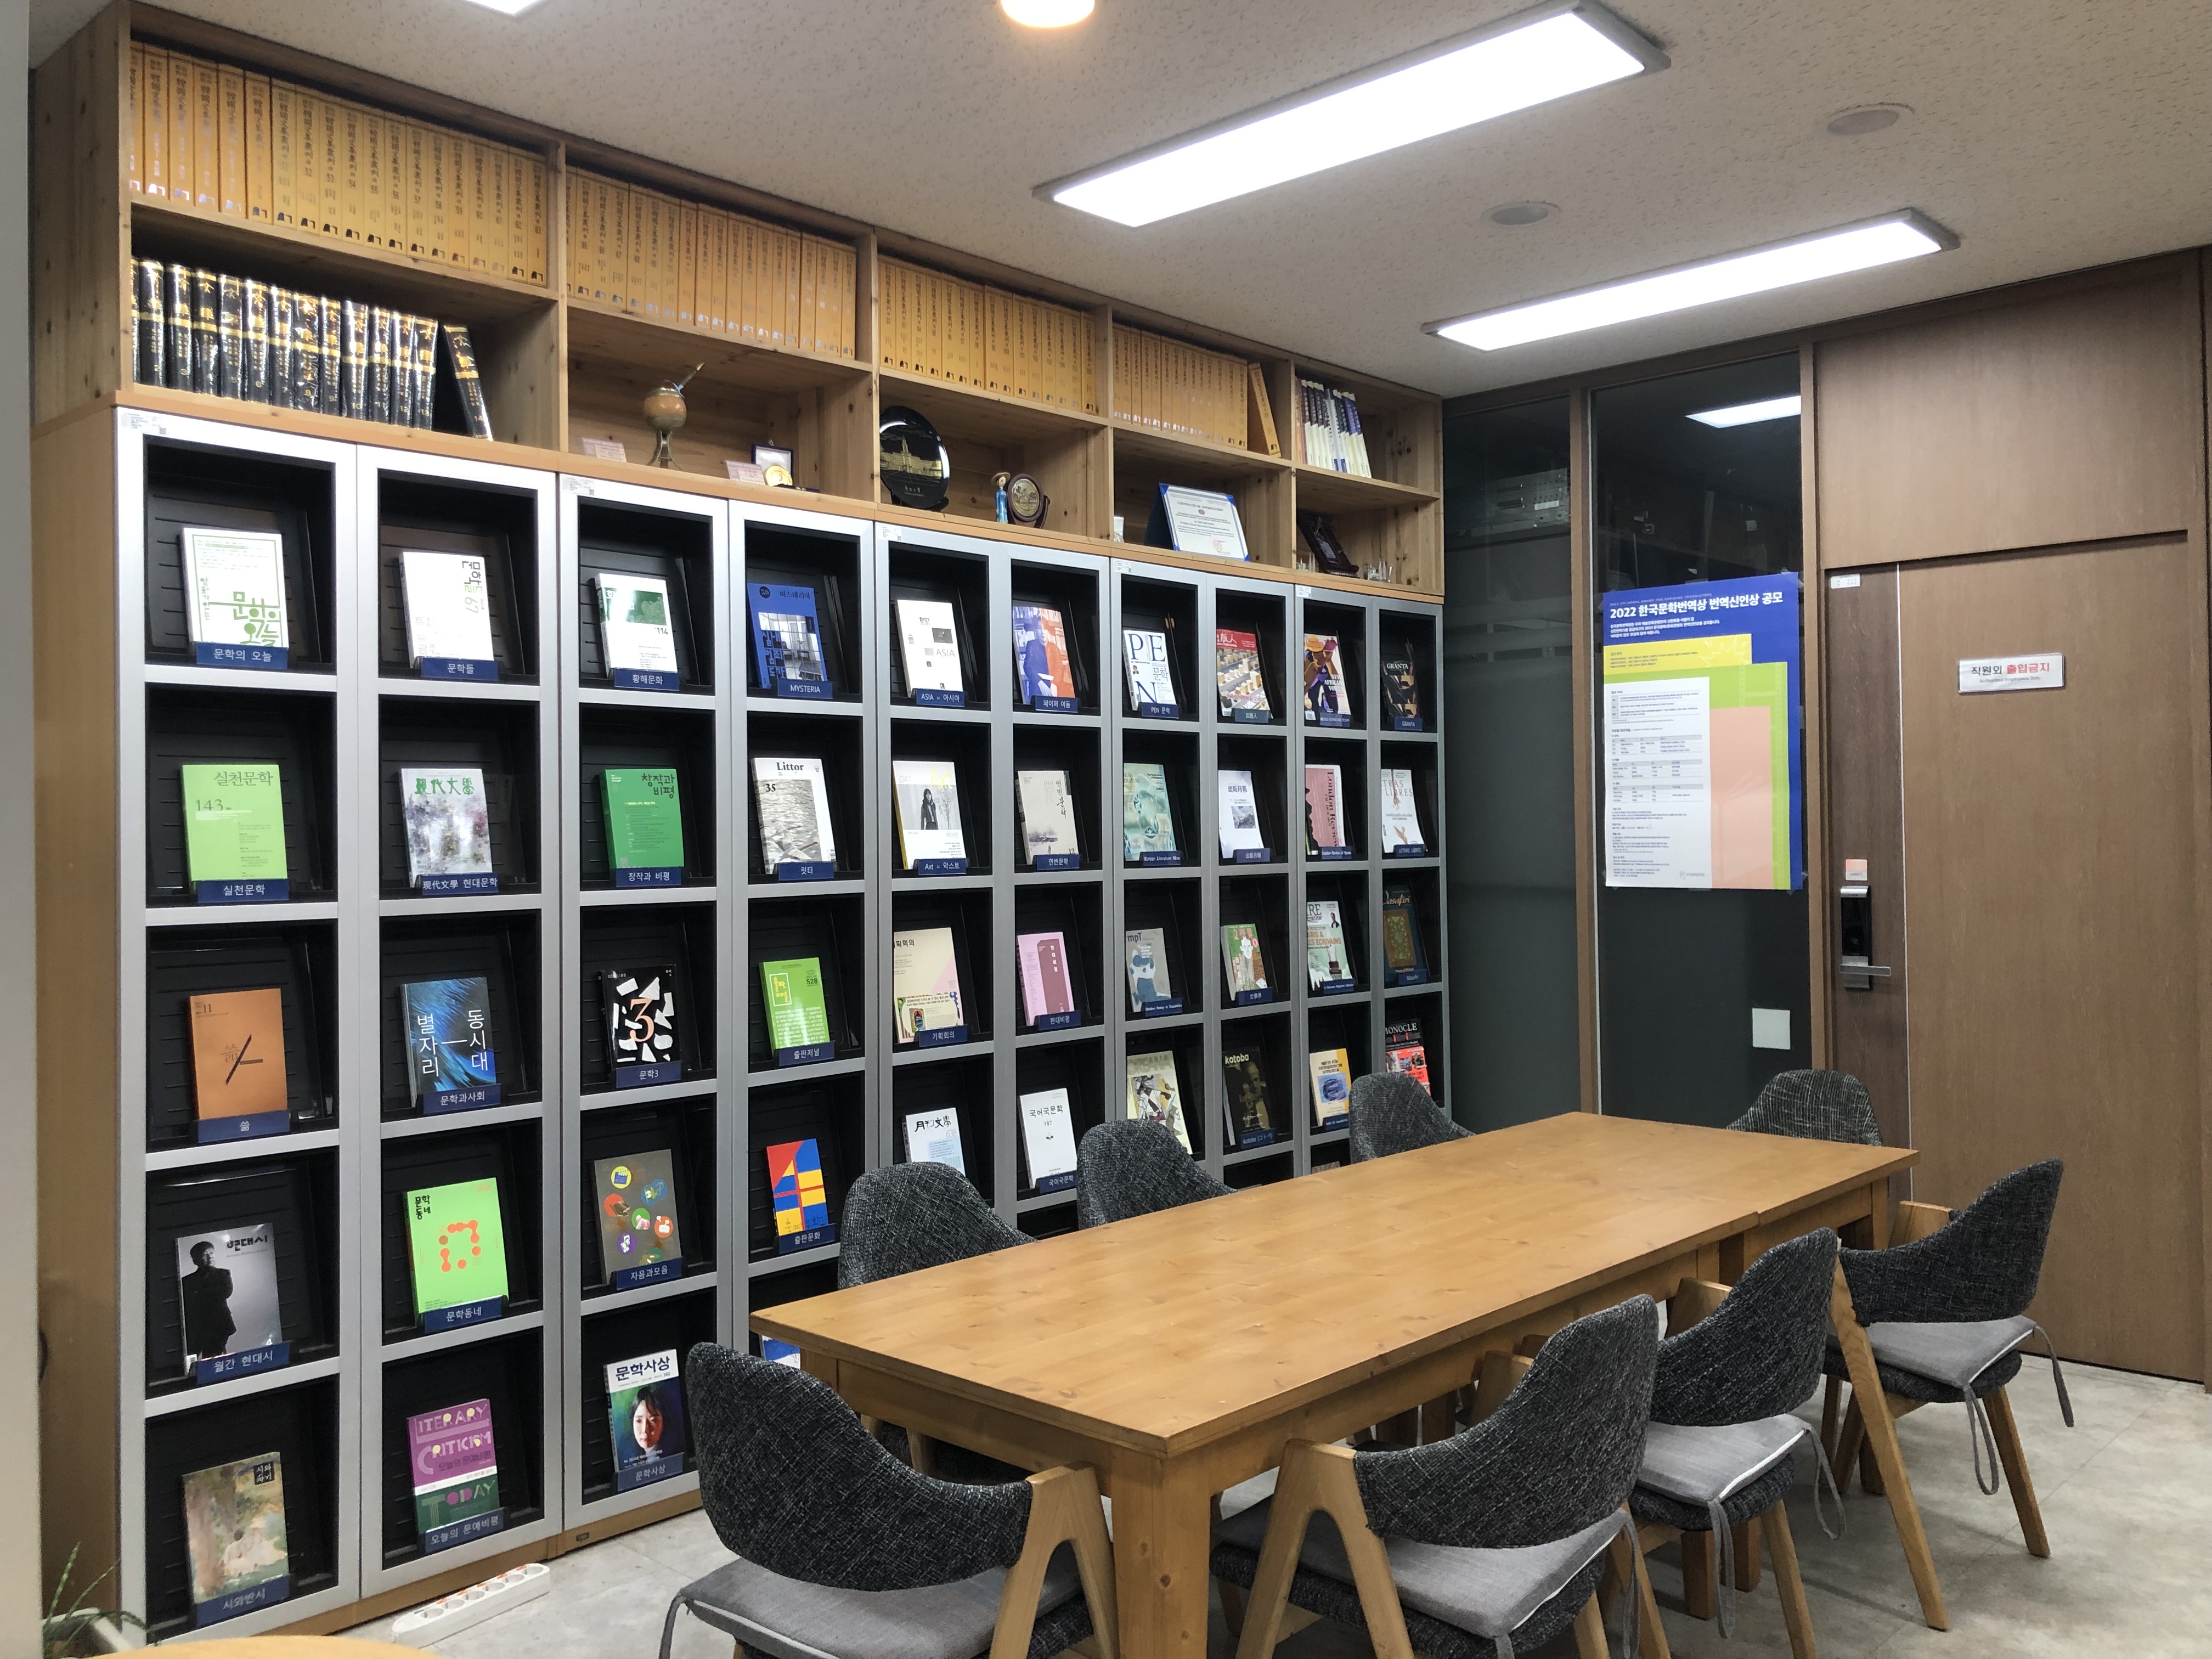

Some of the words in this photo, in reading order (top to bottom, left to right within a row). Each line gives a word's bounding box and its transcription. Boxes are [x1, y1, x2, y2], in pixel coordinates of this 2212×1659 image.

[779, 590, 811, 600] 미스테리아
[1610, 607, 1637, 619] 2022
[1638, 599, 1708, 617] 한국문학번역상
[1709, 593, 1760, 610] 번역신인상
[1762, 591, 1784, 605] 공모
[214, 648, 245, 661] 문학의
[252, 651, 272, 662] 오늘
[936, 648, 955, 657] ASIA
[448, 663, 475, 674] 문학들
[1153, 667, 1169, 681] 문학
[1971, 665, 2002, 675] 직원외
[2007, 662, 2050, 674] 출입금지
[633, 674, 663, 685] 황해문화
[790, 685, 821, 693] MYSTERIA
[1043, 699, 1058, 708] 페이퍼
[776, 762, 804, 771] Littor
[213, 771, 274, 786] 실천문학
[641, 772, 675, 787] 창작과
[653, 786, 674, 799] 비평
[765, 783, 776, 793] 35
[1385, 788, 1413, 797] LIBRES
[1330, 814, 1338, 847] Review
[800, 866, 813, 875] 릿터
[943, 862, 960, 870] 악스트
[628, 872, 652, 881] 창작과
[655, 872, 670, 881] 비평
[223, 884, 266, 896] 실천문학
[423, 880, 458, 890] 現代文學
[463, 878, 498, 888] 현대문학
[1127, 933, 1142, 943] mpT
[203, 1003, 212, 1013] 11
[629, 998, 655, 1042] 3
[1051, 1015, 1070, 1025] 현대비평
[467, 1009, 488, 1071] 동시대
[932, 1031, 955, 1041] 기획회의
[417, 1013, 439, 1077] 별자리
[794, 1048, 820, 1059] 출판저널
[1224, 1053, 1249, 1064] kotoba
[639, 1070, 658, 1080] 문학3
[440, 1091, 485, 1105] 문학과사회
[1029, 1104, 1064, 1118] 국어국문학
[915, 1115, 951, 1132] 月刊文學
[1048, 1175, 1074, 1187] 국어국문학
[415, 1195, 431, 1207] 문학
[416, 1206, 431, 1220] 동네
[794, 1231, 821, 1245] 출판문화
[630, 1265, 668, 1280] 자음과모음
[446, 1306, 482, 1322] 문학동네
[215, 1359, 235, 1373] 월간
[241, 1350, 273, 1367] 현대시
[616, 1356, 670, 1381] 문학사상
[438, 1458, 462, 1471] 오늘의
[635, 1464, 666, 1481] 문학사상
[431, 1528, 459, 1544] 오늘의
[463, 1515, 499, 1534] 문예비평
[223, 1588, 266, 1610] 시와반시
